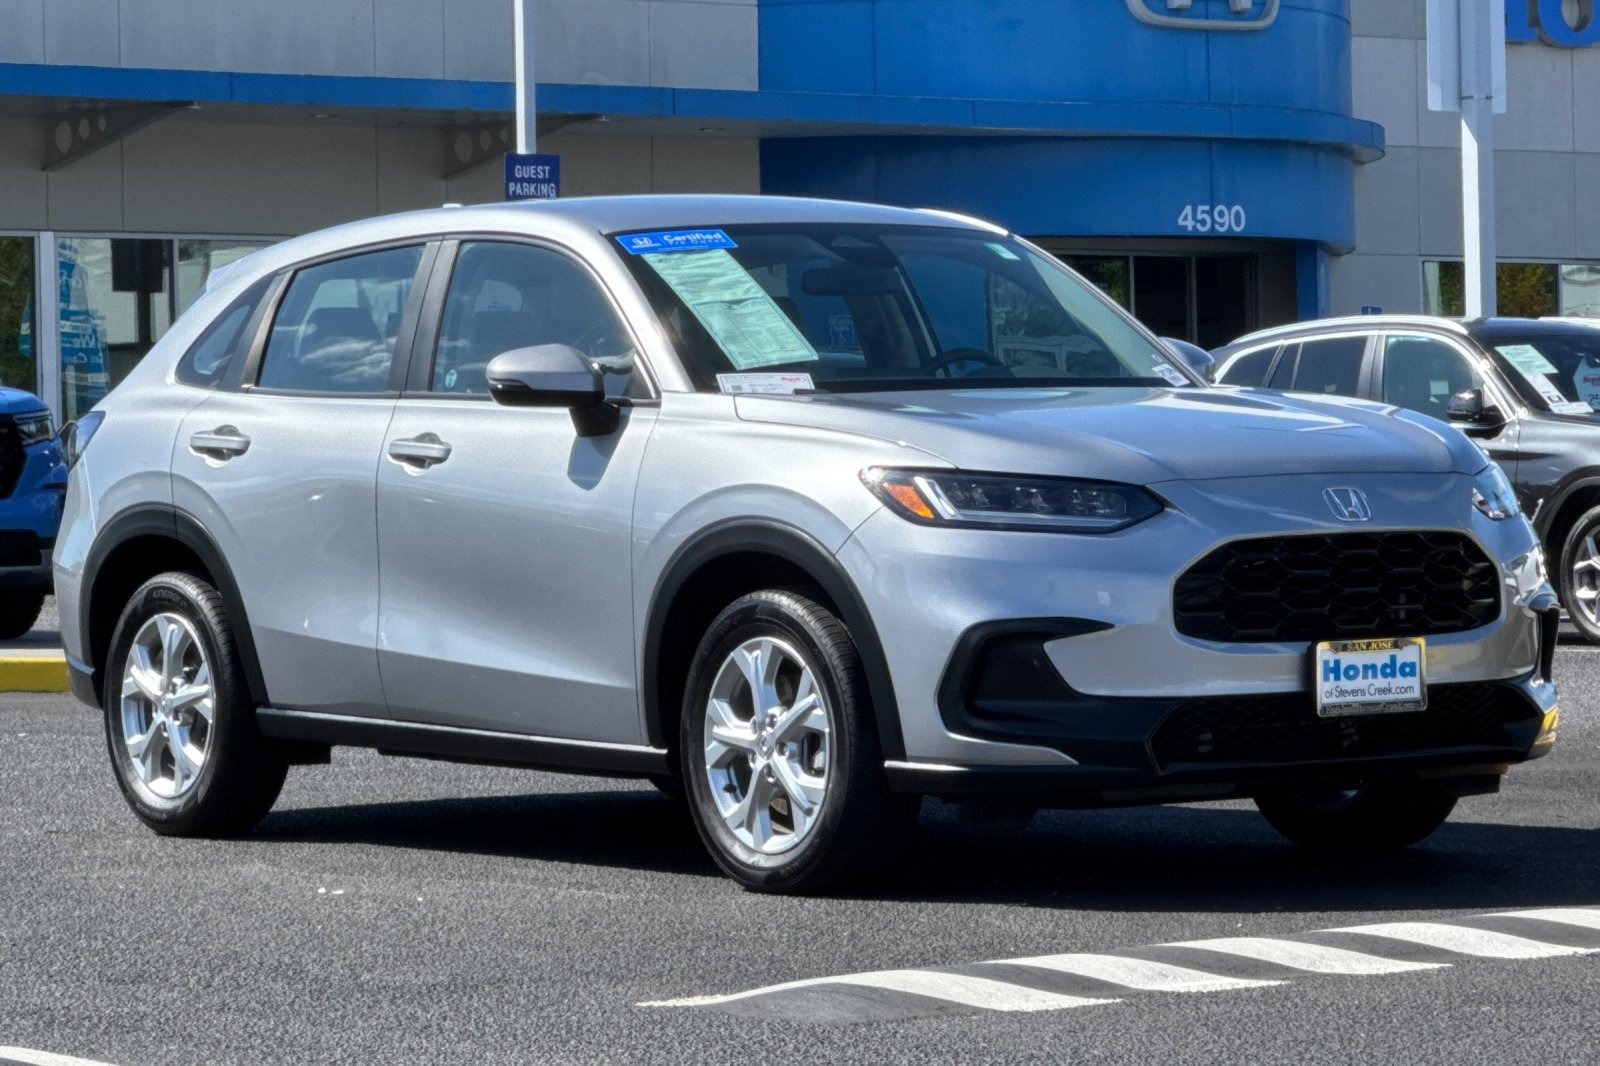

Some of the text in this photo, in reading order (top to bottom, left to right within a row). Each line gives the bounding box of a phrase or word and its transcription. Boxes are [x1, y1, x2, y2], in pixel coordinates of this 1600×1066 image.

[514, 165, 550, 179] GUEST
[509, 182, 556, 197] PARKING
[1177, 204, 1246, 232] 4590
[663, 232, 723, 242] Certified
[1347, 640, 1394, 651] SAN JOSE
[1322, 654, 1417, 682] Honda
[1325, 681, 1415, 699] of Stevens Creek.com
